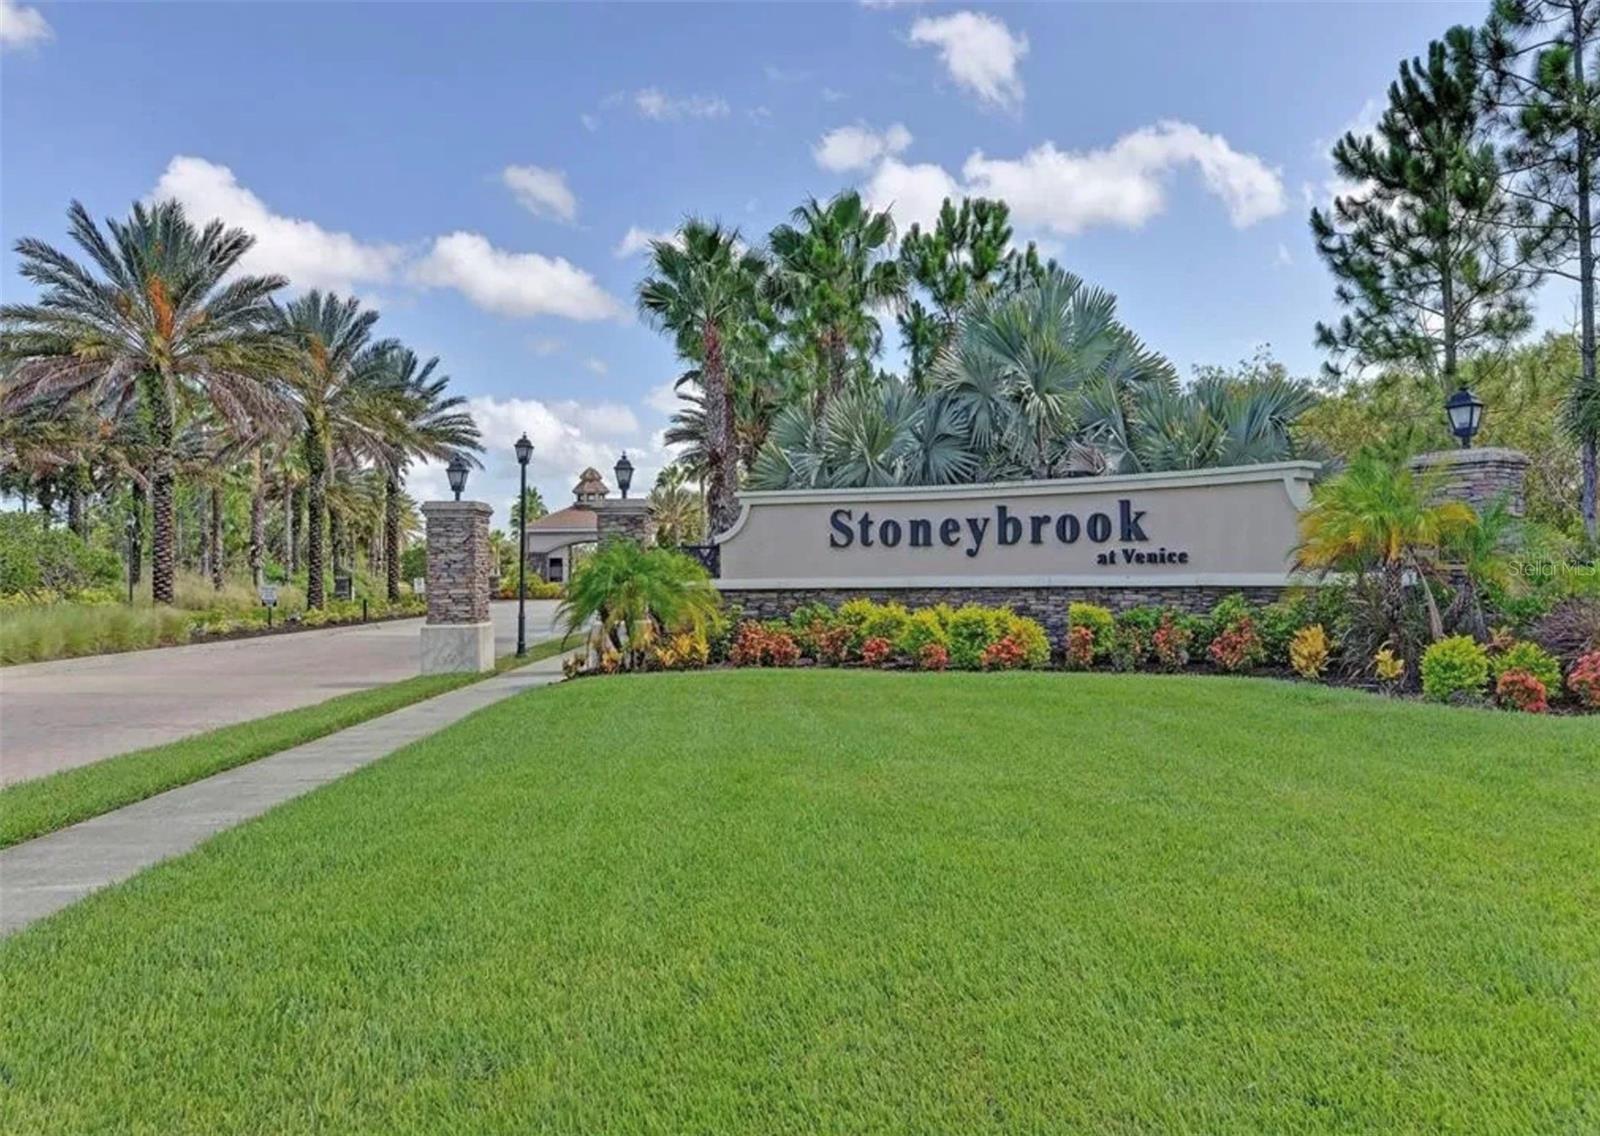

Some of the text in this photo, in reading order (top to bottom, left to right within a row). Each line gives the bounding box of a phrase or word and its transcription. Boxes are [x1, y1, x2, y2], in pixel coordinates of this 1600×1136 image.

[829, 500, 1149, 557] Stoneybrook
[1096, 548, 1189, 565] at Venice
